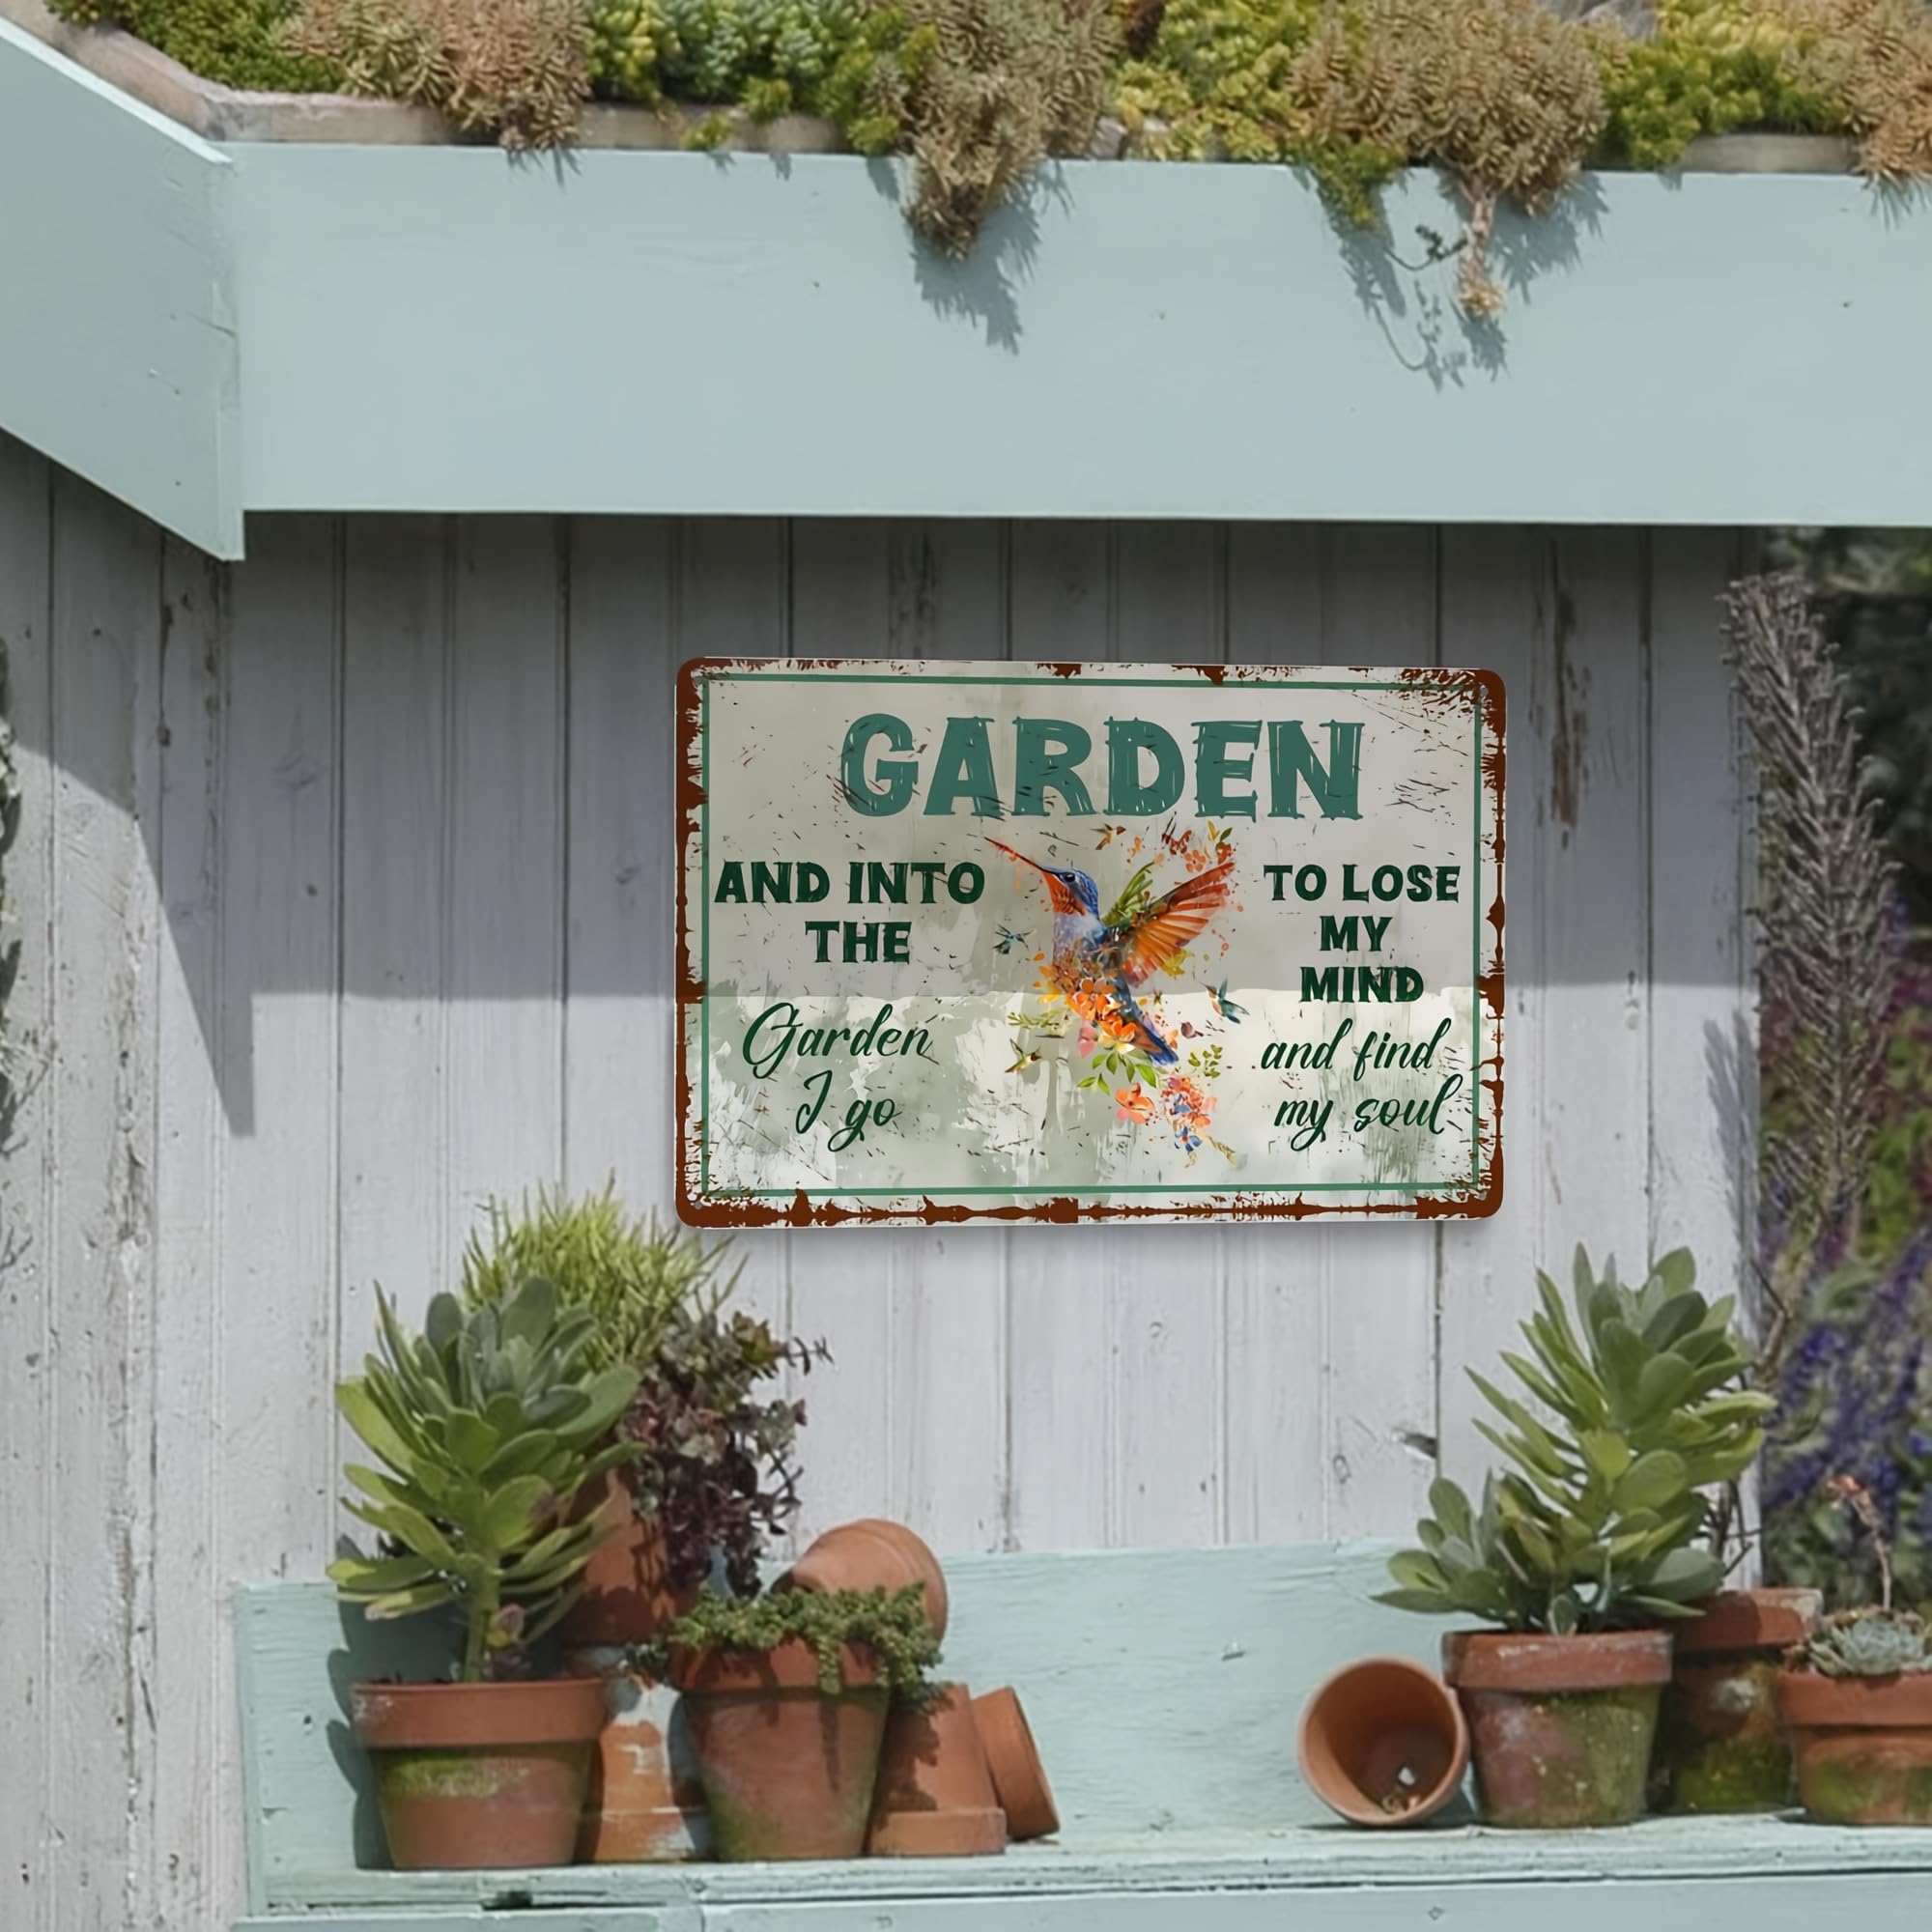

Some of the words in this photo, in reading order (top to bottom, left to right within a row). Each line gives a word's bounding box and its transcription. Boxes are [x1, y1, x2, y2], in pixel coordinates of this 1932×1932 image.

[841, 713, 1364, 820] GARDEN
[714, 861, 831, 904] AND
[847, 861, 985, 904] INTO
[1263, 864, 1327, 902] TO
[1342, 864, 1461, 903] LOSE
[805, 920, 912, 964] THE
[1319, 915, 1393, 952] MY
[1298, 966, 1425, 1004] MIND
[742, 1002, 933, 1079] Garden
[1260, 1017, 1352, 1070] and
[1352, 1017, 1452, 1083] find
[795, 1069, 833, 1134] I
[828, 1096, 898, 1152] go
[1273, 1095, 1330, 1152] my
[1353, 1074, 1463, 1135] soul
